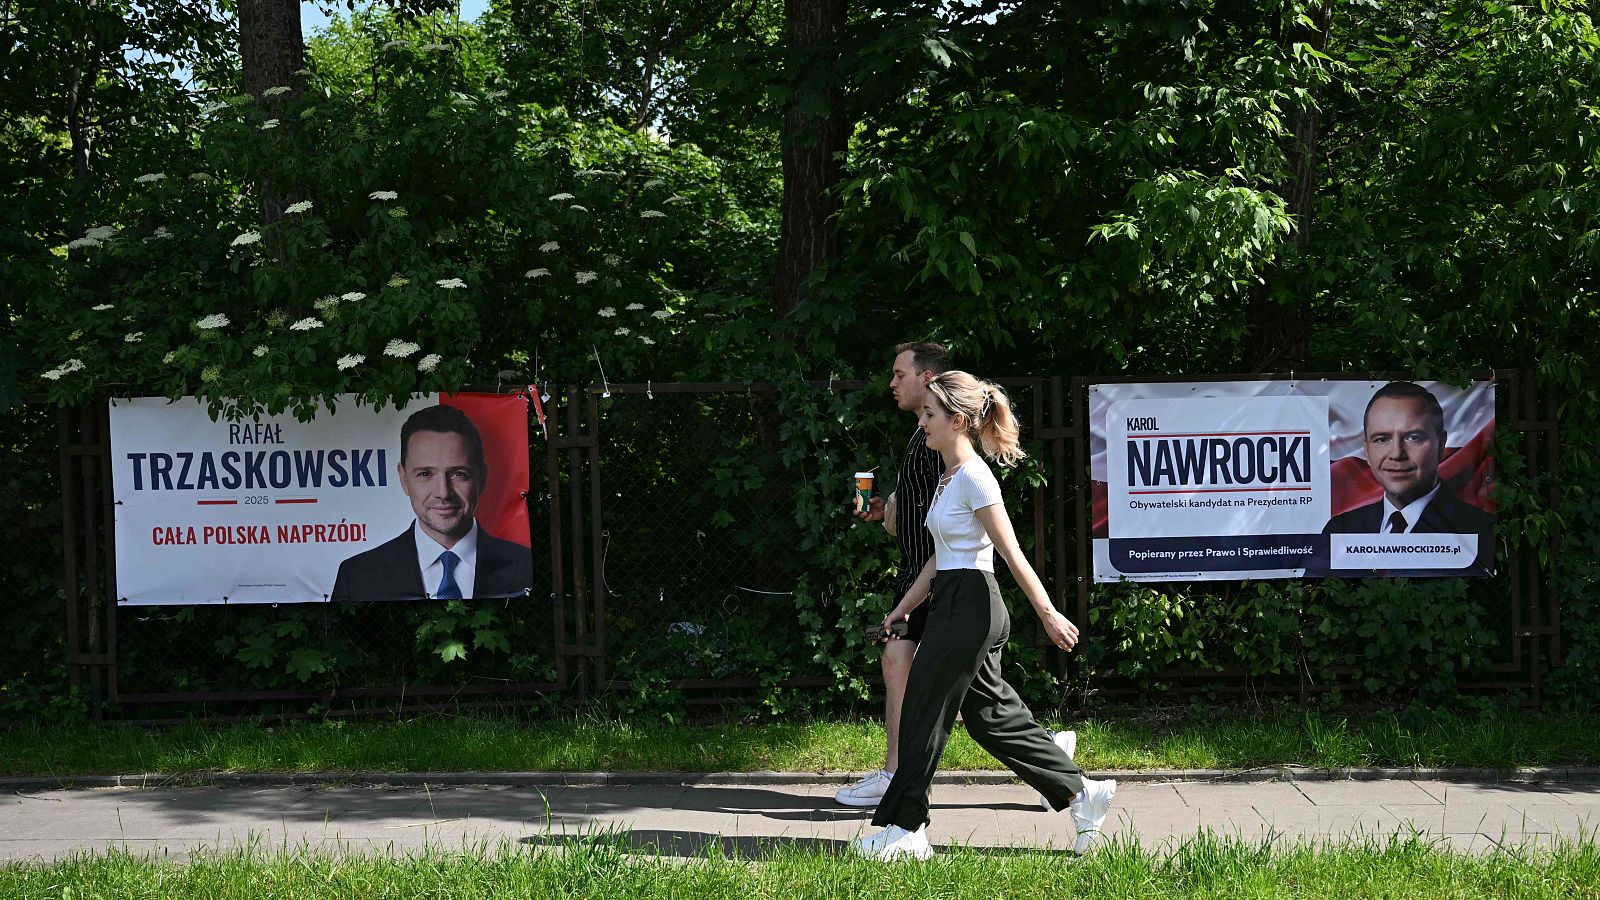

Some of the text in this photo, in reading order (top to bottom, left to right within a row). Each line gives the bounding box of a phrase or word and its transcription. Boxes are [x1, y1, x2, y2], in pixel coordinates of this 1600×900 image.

[1127, 417, 1159, 431] KAROL
[229, 423, 285, 445] RAFAŁ
[127, 448, 388, 490] TRZASKOWSKI
[1127, 437, 1310, 487] NAWROCKI
[244, 496, 269, 506] 2025
[1129, 498, 1187, 509] Obywatelski
[1189, 498, 1231, 509] kandydat
[1247, 497, 1297, 508] Prezydenta
[1300, 496, 1313, 504] RP
[152, 519, 368, 546] CAŁA POLSKA NAPRZÓD!
[1128, 549, 1176, 560] Popierany
[1179, 550, 1204, 560] przez
[1206, 547, 1235, 557] Prawo
[1243, 545, 1313, 558] Sprawiedliwość
[1346, 545, 1461, 555] KAROLNAWROCKI2025.pl
